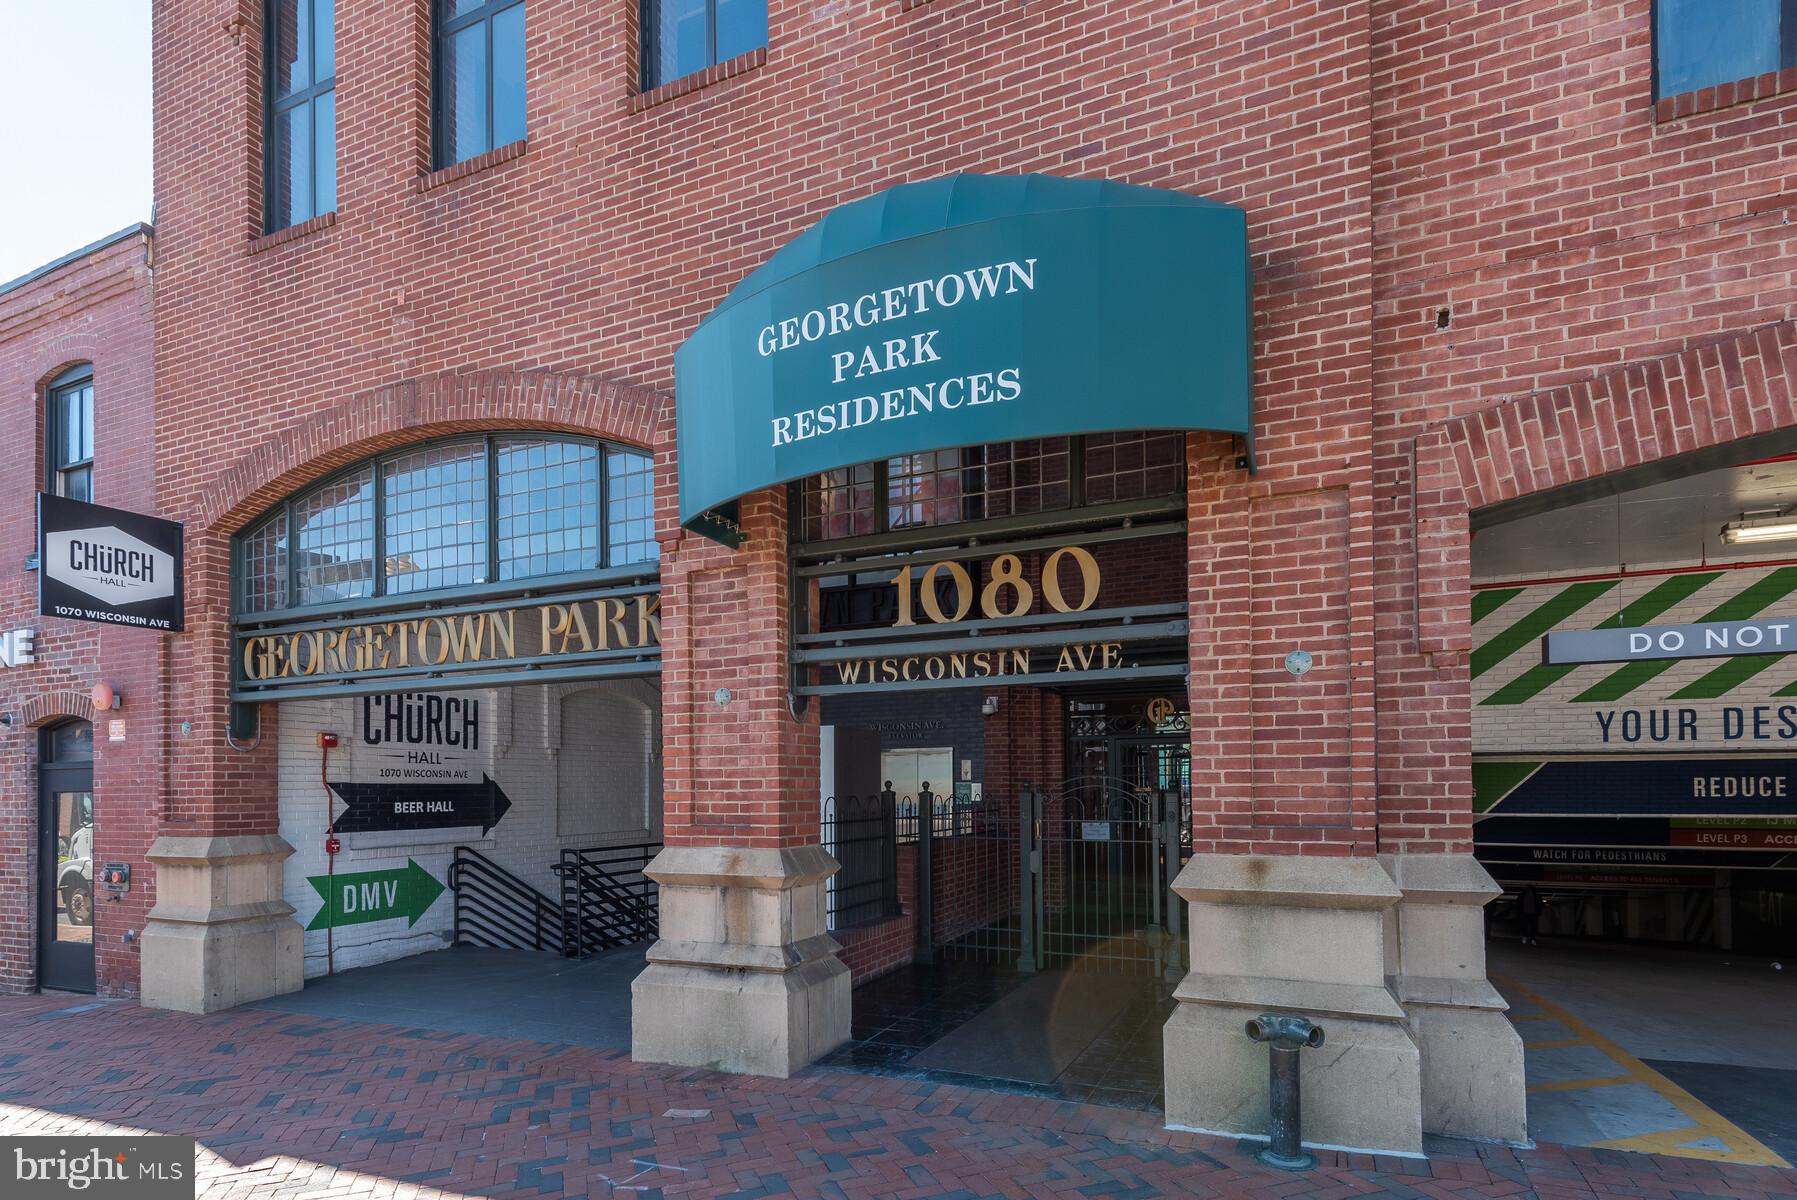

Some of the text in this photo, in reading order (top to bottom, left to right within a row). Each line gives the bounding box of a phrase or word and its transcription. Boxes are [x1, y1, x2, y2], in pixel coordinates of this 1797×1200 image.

[757, 258, 1037, 356] GEORGETOWN
[831, 330, 941, 383] PARK
[771, 367, 1022, 447] RESIDENCES
[100, 577, 126, 588] HALL
[890, 546, 1101, 628] 1080
[55, 605, 170, 629] 1070 WISCONSIN AVE
[243, 593, 661, 681] GEORGETOWN PARK
[1629, 624, 1790, 653] DO NOT
[836, 649, 1031, 685] WISCONSIN
[1595, 705, 1797, 743] YOUR DES
[408, 751, 442, 765] HALL
[379, 768, 468, 779] 1070 WISCONSIN AVE
[1693, 776, 1787, 798] REDUCE
[394, 801, 454, 814] BEER HALL
[1696, 833, 1730, 843] LEVEL
[1734, 834, 1748, 843] P3
[1532, 849, 1667, 862] WATCH FOR PEDESTRIANS
[343, 880, 398, 914] DMV
